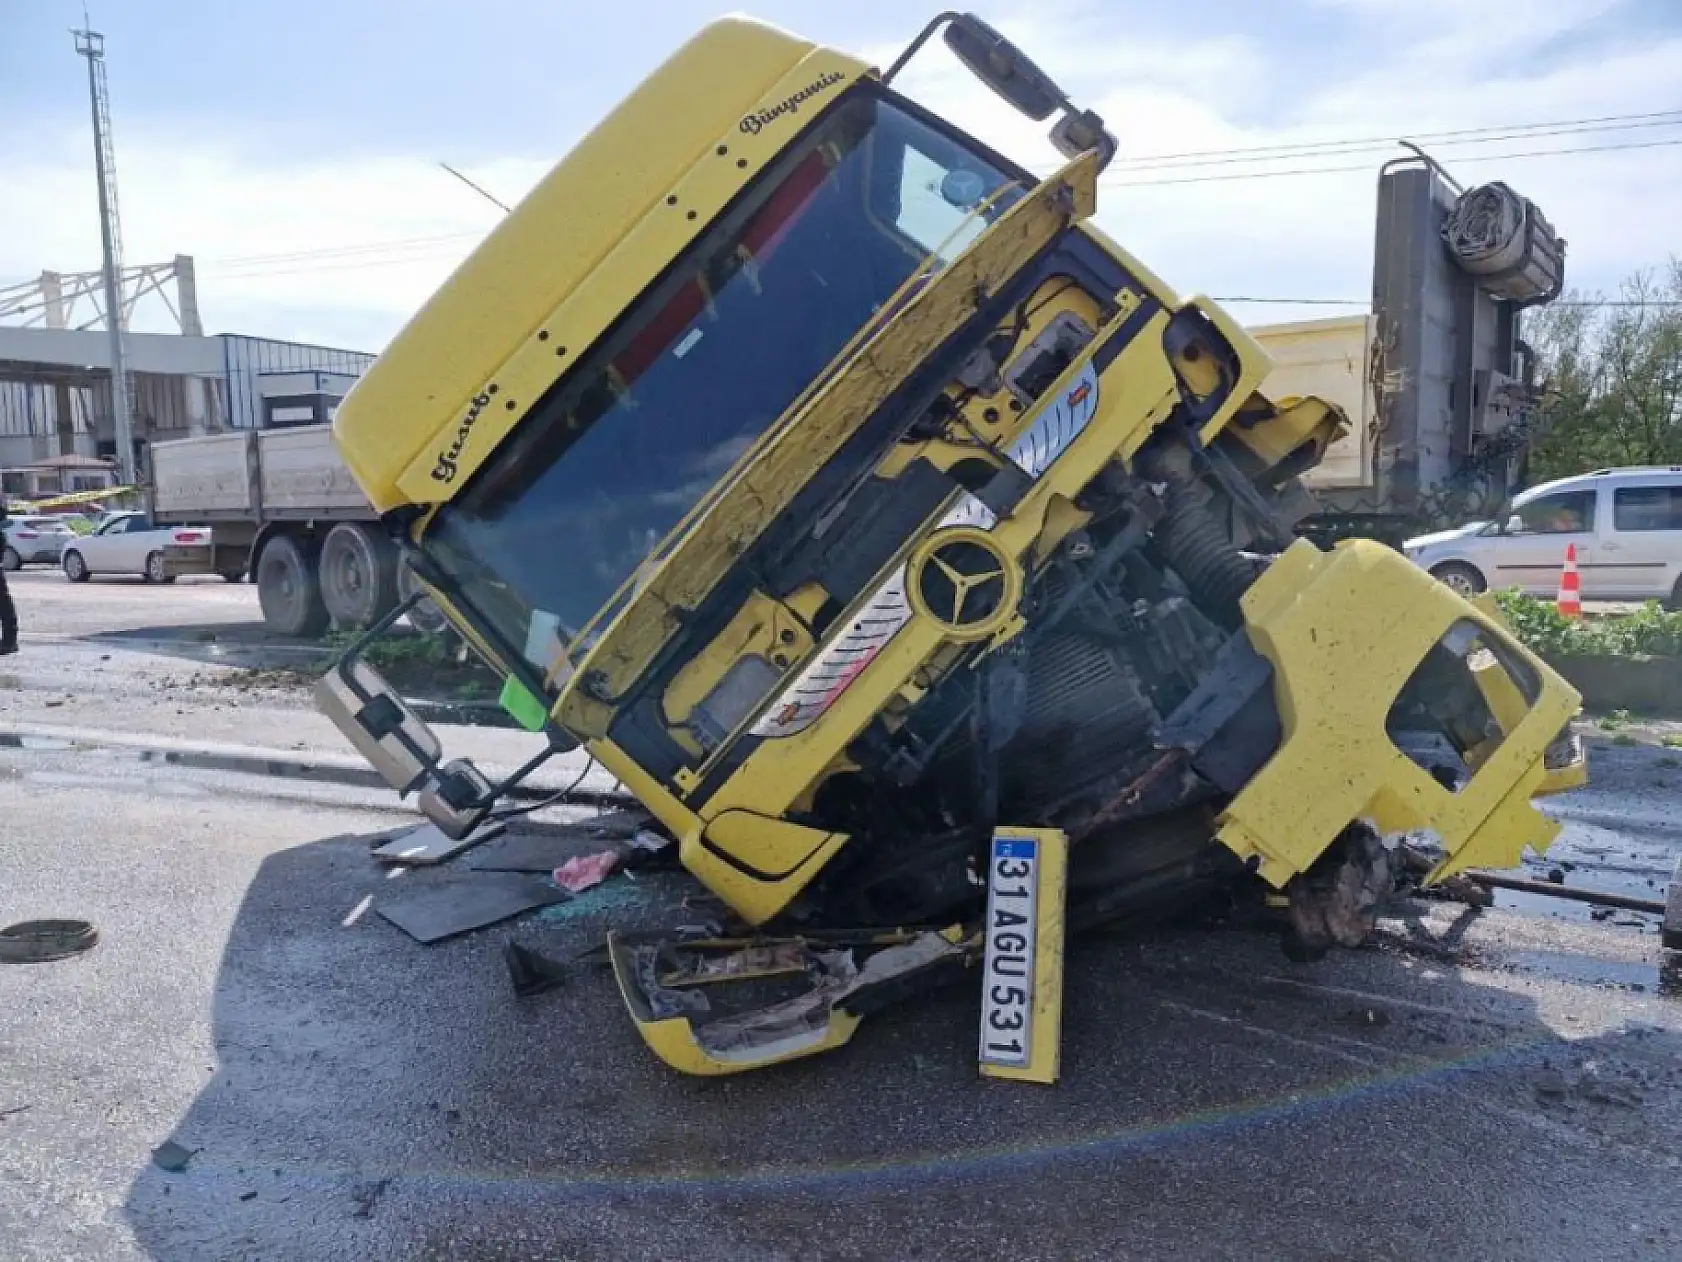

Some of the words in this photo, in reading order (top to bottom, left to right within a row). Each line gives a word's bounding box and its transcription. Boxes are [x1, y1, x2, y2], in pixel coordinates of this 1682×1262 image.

[739, 71, 845, 135] Bünyamin
[994, 859, 1030, 899] 31
[991, 909, 1029, 977] AGU
[987, 984, 1026, 1055] 531
